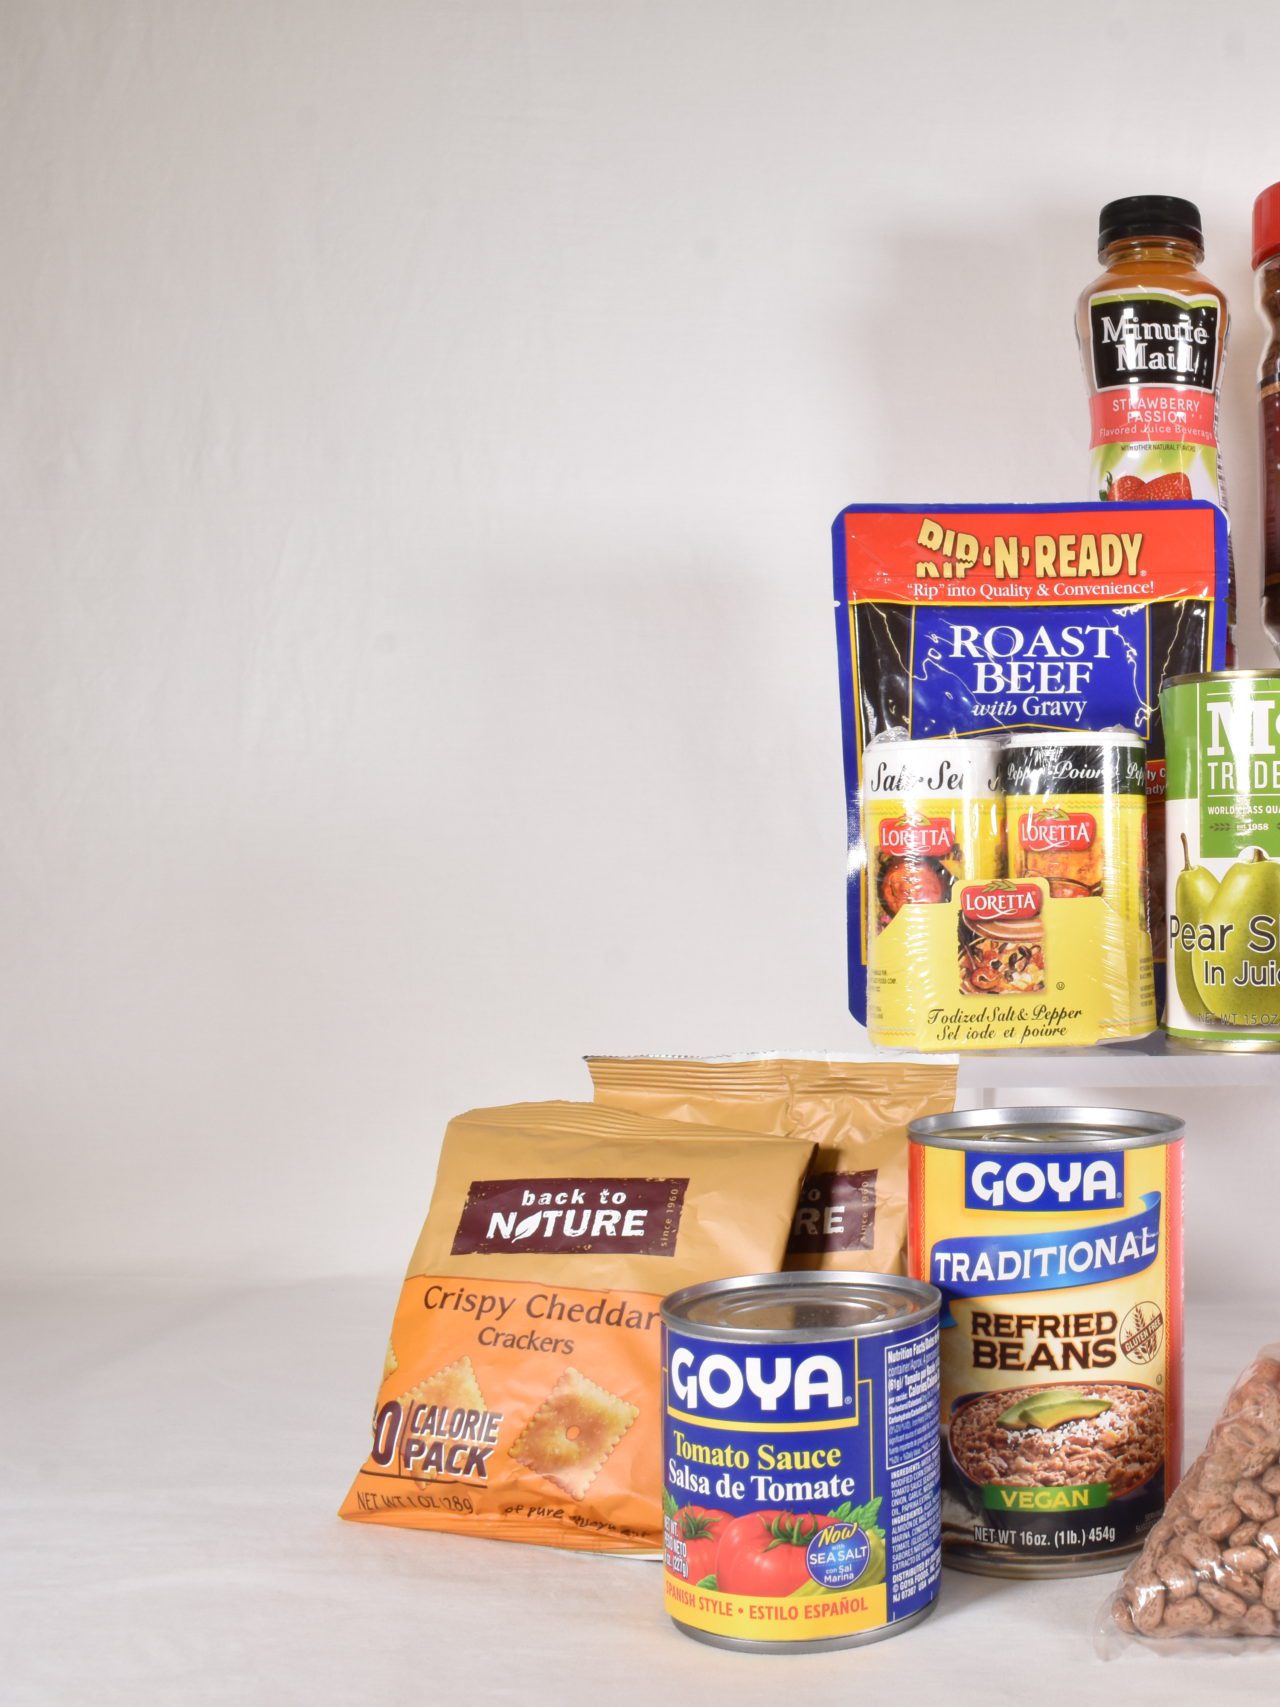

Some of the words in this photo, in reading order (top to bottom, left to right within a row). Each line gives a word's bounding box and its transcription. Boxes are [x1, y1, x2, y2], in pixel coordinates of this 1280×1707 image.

[1101, 315, 1209, 344] Minute
[1113, 397, 1200, 412] STRAWBERRY
[1127, 411, 1187, 423] PASSION
[1099, 425, 1137, 437] Flavored
[1141, 424, 1171, 433] Juice
[915, 518, 980, 579] RIP
[1034, 532, 1143, 578] READY
[947, 583, 976, 597] into
[979, 583, 1032, 600] Quality
[1036, 585, 1050, 597] &
[1053, 581, 1155, 596] Convenience!
[949, 624, 1120, 659] ROAST
[973, 661, 1093, 694] BEEF
[971, 700, 1018, 717] with
[1023, 697, 1088, 722] Gravy
[1208, 806, 1235, 815] WORLD
[881, 826, 951, 851] LORETTA
[1021, 821, 1089, 847] LORETTA
[965, 890, 1036, 916] LORETTA
[1170, 914, 1234, 952] Pear
[1204, 961, 1225, 985] In
[987, 1006, 1016, 1023] Salt
[1017, 1009, 1029, 1021] &
[1032, 1004, 1084, 1023] Pepper
[1200, 1013, 1216, 1024] NET
[1245, 1014, 1257, 1025] 15
[1260, 1014, 1278, 1025] OZ
[937, 1024, 959, 1041] Sel
[1003, 1025, 1016, 1037] et
[1020, 1024, 1067, 1044] poivre
[971, 1160, 1116, 1207] GOYA
[521, 1189, 586, 1206] back
[599, 1188, 627, 1205] to
[659, 1218, 672, 1248] since
[666, 1188, 679, 1214] 1960
[934, 1227, 1158, 1282] TRADITIONAL
[423, 1285, 516, 1321] Crispy
[526, 1294, 661, 1330] Cheddar
[971, 1311, 1118, 1339] REFRIED
[1125, 1331, 1149, 1352] GLUTEN
[1149, 1317, 1161, 1334] FREE
[478, 1326, 575, 1355] Crackers
[888, 1347, 912, 1364] Nutrition
[972, 1338, 1117, 1372] BEANS
[671, 1348, 843, 1411] GOYA
[410, 1403, 504, 1443] CALORIE
[404, 1438, 495, 1479] PACK
[673, 1430, 750, 1470] Tomato
[758, 1444, 842, 1471] Sauce
[669, 1459, 711, 1494] Salsa
[715, 1473, 745, 1499] de
[750, 1474, 855, 1502] Tomate
[357, 1491, 379, 1511] NET
[418, 1496, 440, 1509] OZ
[1001, 1489, 1089, 1508] VEGAN
[505, 1505, 523, 1514] of
[527, 1507, 565, 1519] pure
[818, 1522, 858, 1548] Now
[974, 1527, 995, 1542] NET
[998, 1530, 1017, 1545] WT
[1088, 1525, 1116, 1542] 454g
[674, 1538, 687, 1558] NETO
[810, 1552, 836, 1565] SEA
[838, 1546, 867, 1561] SALT
[824, 1573, 854, 1583] Marina
[839, 1564, 852, 1573] Sal
[900, 1579, 914, 1590] GOYA
[666, 1580, 696, 1608] SPANISH
[699, 1596, 733, 1617] STYLE
[750, 1605, 798, 1621] ESTILO
[804, 1597, 869, 1620] ESPAÑOL
[893, 1594, 900, 1604] NJ
